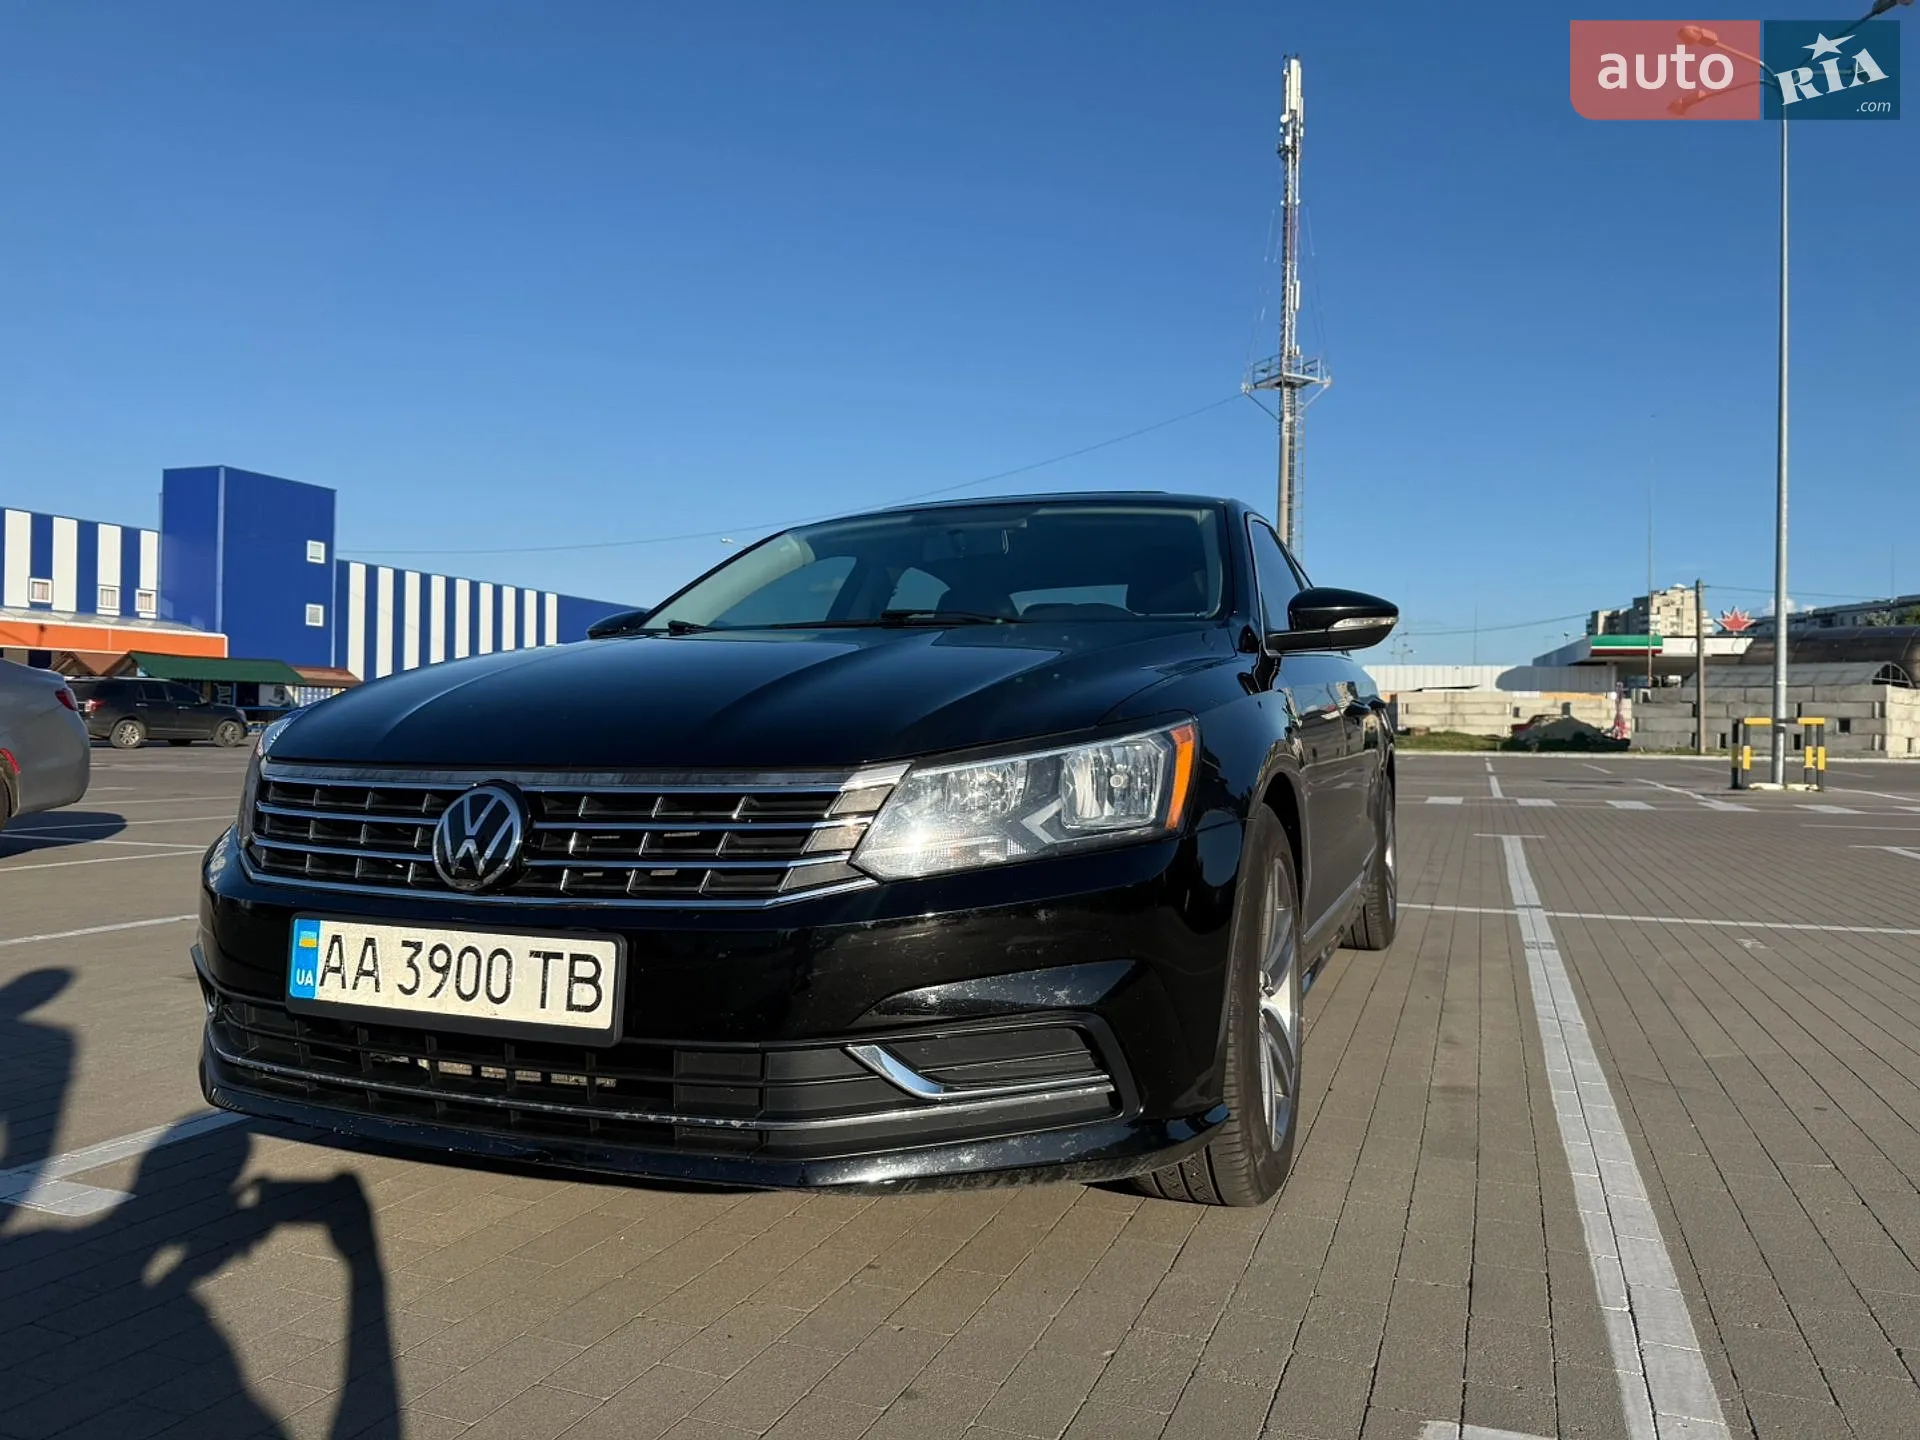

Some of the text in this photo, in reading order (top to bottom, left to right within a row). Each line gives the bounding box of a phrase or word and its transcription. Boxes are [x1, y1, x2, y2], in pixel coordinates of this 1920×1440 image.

[437, 786, 518, 884] VW
[296, 968, 315, 987] UA
[318, 934, 604, 1013] AA 3900 TB
